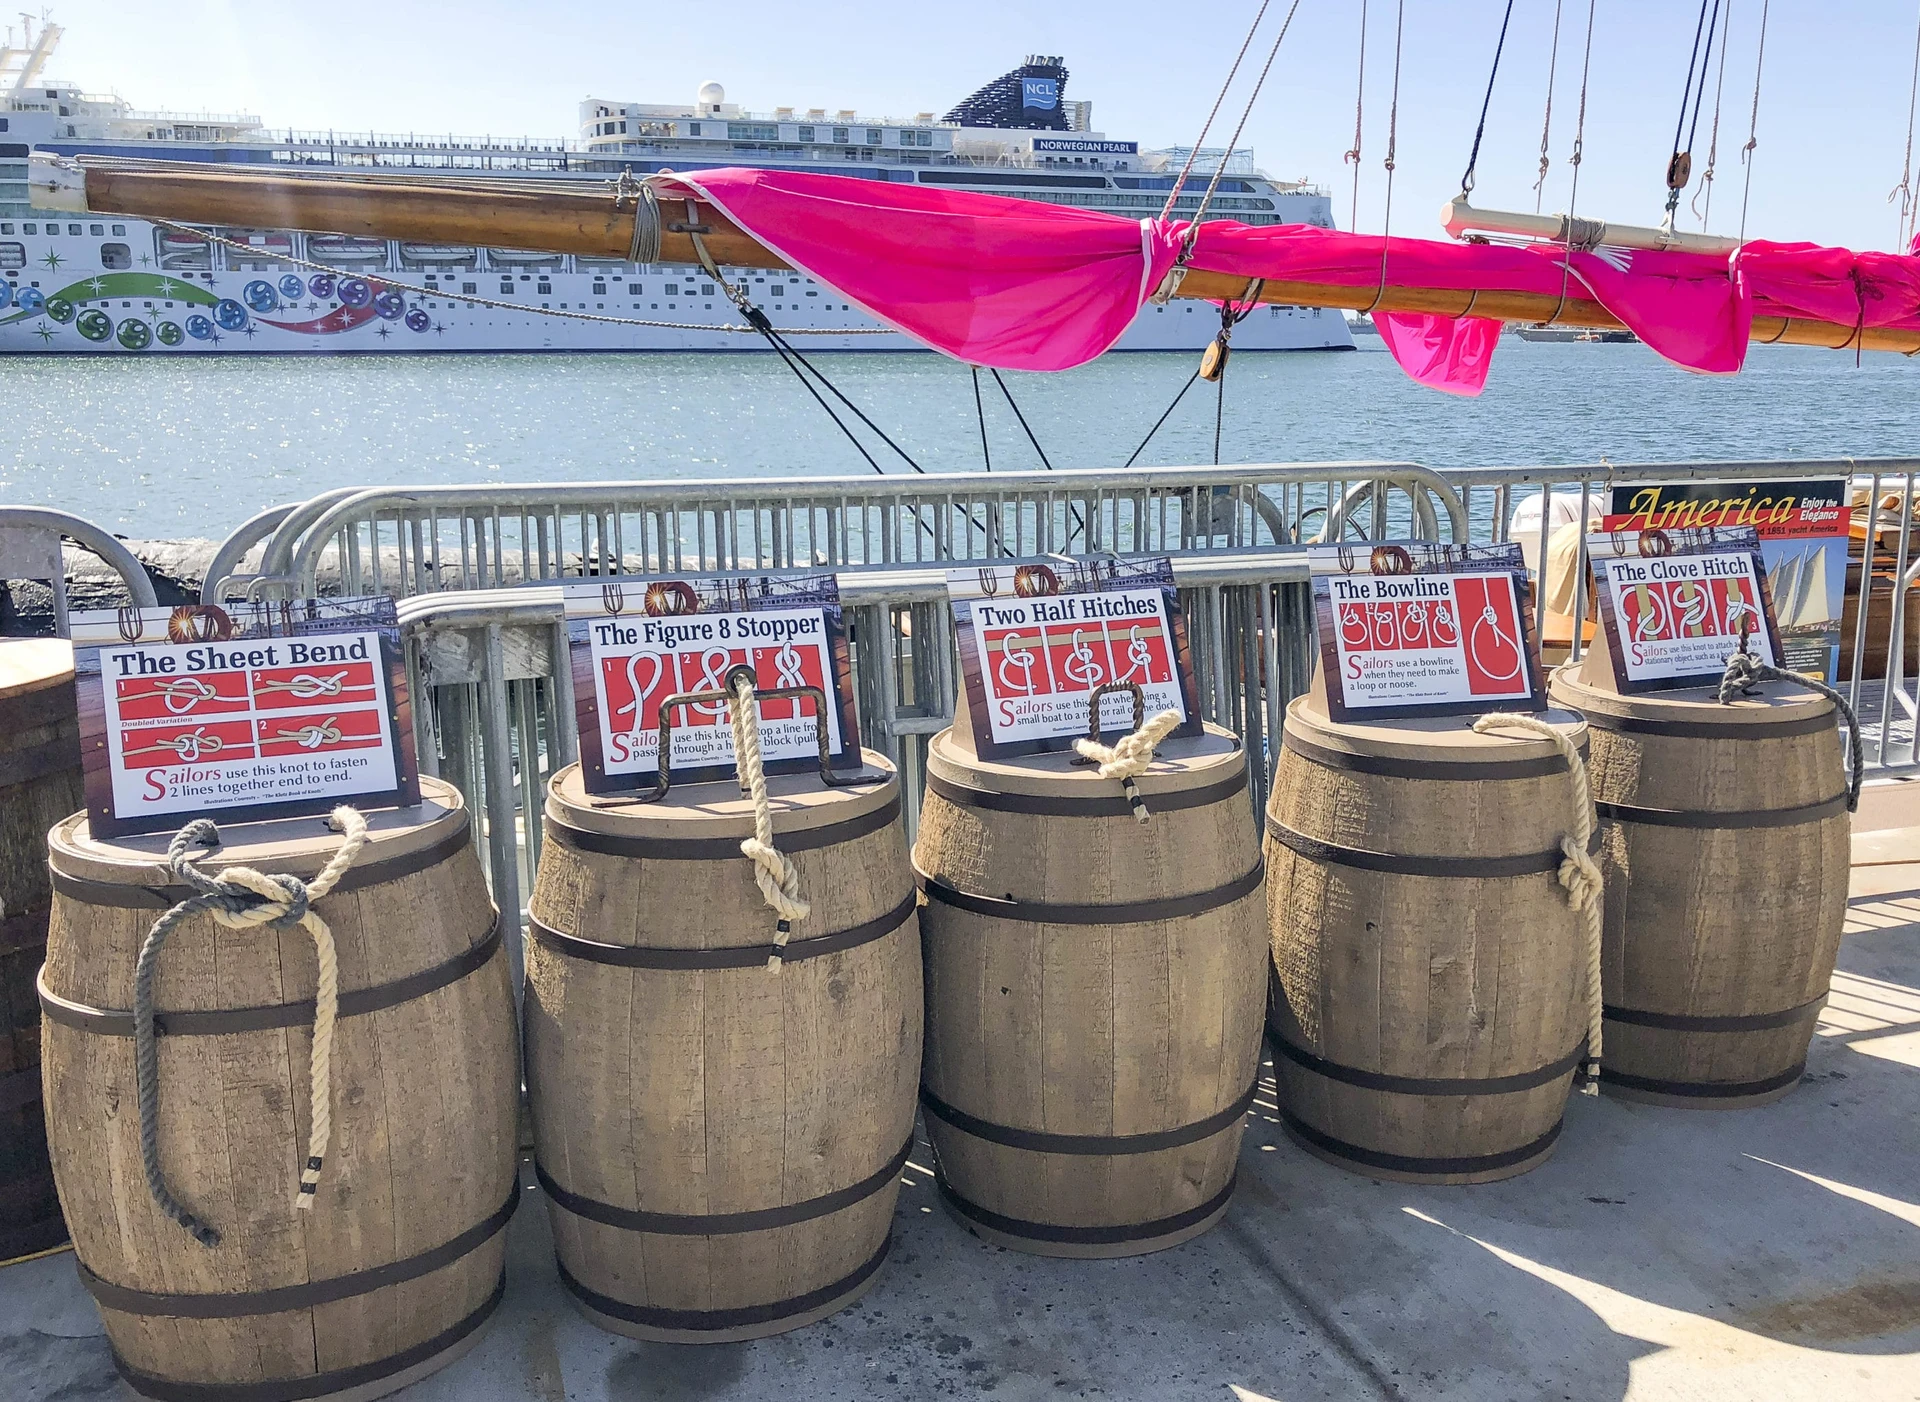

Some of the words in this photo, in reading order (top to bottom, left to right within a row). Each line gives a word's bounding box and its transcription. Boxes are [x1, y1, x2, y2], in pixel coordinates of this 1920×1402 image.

[1026, 83, 1053, 95] NCL
[1040, 140, 1101, 152] NORWEGIAN
[1103, 143, 1131, 153] PEARL
[1614, 486, 1796, 531] America
[1801, 497, 1826, 511] Enjoy
[1826, 499, 1838, 507] the
[1800, 510, 1839, 523] Elegance
[1810, 525, 1838, 533] America
[1612, 563, 1646, 582] The
[1650, 560, 1698, 579] Clove
[1703, 556, 1750, 576] Hitch
[1335, 580, 1370, 599] The
[1374, 577, 1450, 598] Bowline
[979, 605, 1026, 626] Two
[1031, 599, 1076, 622] Half
[1080, 594, 1158, 619] Hitches
[595, 622, 638, 646] The
[643, 620, 713, 648] Figure
[719, 618, 731, 639] 8
[737, 616, 820, 641] Stopper
[1708, 625, 1714, 633] 2
[1751, 621, 1757, 630] 3
[112, 651, 176, 676] The
[186, 645, 279, 672] Sheet
[288, 637, 370, 664] Bend
[684, 653, 691, 664] 2
[756, 649, 763, 660] 3
[1631, 643, 1668, 666] Sailors
[606, 661, 612, 672] 1
[1347, 654, 1394, 680] Sailors
[1396, 659, 1410, 668] use
[1419, 657, 1454, 667] bowline
[1364, 669, 1386, 679] when
[1388, 669, 1405, 680] they
[1407, 668, 1426, 678] need
[1428, 668, 1437, 676] to
[1438, 666, 1460, 676] make
[254, 672, 261, 682] 2
[1162, 672, 1169, 681] 3
[120, 681, 125, 691] 1
[995, 687, 1001, 697] 1
[1057, 682, 1064, 691] 2
[1357, 681, 1376, 692] loop
[1389, 681, 1417, 689] noose.
[999, 700, 1053, 727] Sailors
[1056, 702, 1071, 710] use
[1073, 699, 1088, 709] this
[1144, 691, 1160, 703] ying
[1017, 714, 1040, 725] small
[1042, 712, 1062, 723] boat
[1064, 712, 1073, 721] to
[1112, 705, 1126, 715] rail
[1155, 700, 1179, 711] dock.
[121, 719, 155, 728] Doubled
[156, 716, 193, 725] Variation
[260, 720, 267, 730] 2
[776, 726, 781, 734] a
[783, 723, 801, 734] line
[804, 721, 817, 732] fro
[124, 732, 129, 742] 1
[764, 735, 792, 747] block
[610, 732, 658, 763] Sailo
[675, 733, 692, 743] use
[694, 730, 712, 741] this
[633, 746, 660, 761] passi
[673, 742, 714, 756] through
[717, 743, 723, 751] a
[142, 767, 221, 801] Sailors
[226, 769, 248, 779] use
[253, 765, 276, 776] this
[280, 762, 310, 774] knot
[313, 760, 326, 771] to
[330, 758, 368, 769] fasten
[170, 787, 178, 798] 2
[182, 785, 214, 797] lines
[217, 778, 275, 795] together
[279, 774, 303, 787] end
[307, 774, 320, 784] to
[324, 770, 352, 783] end.
